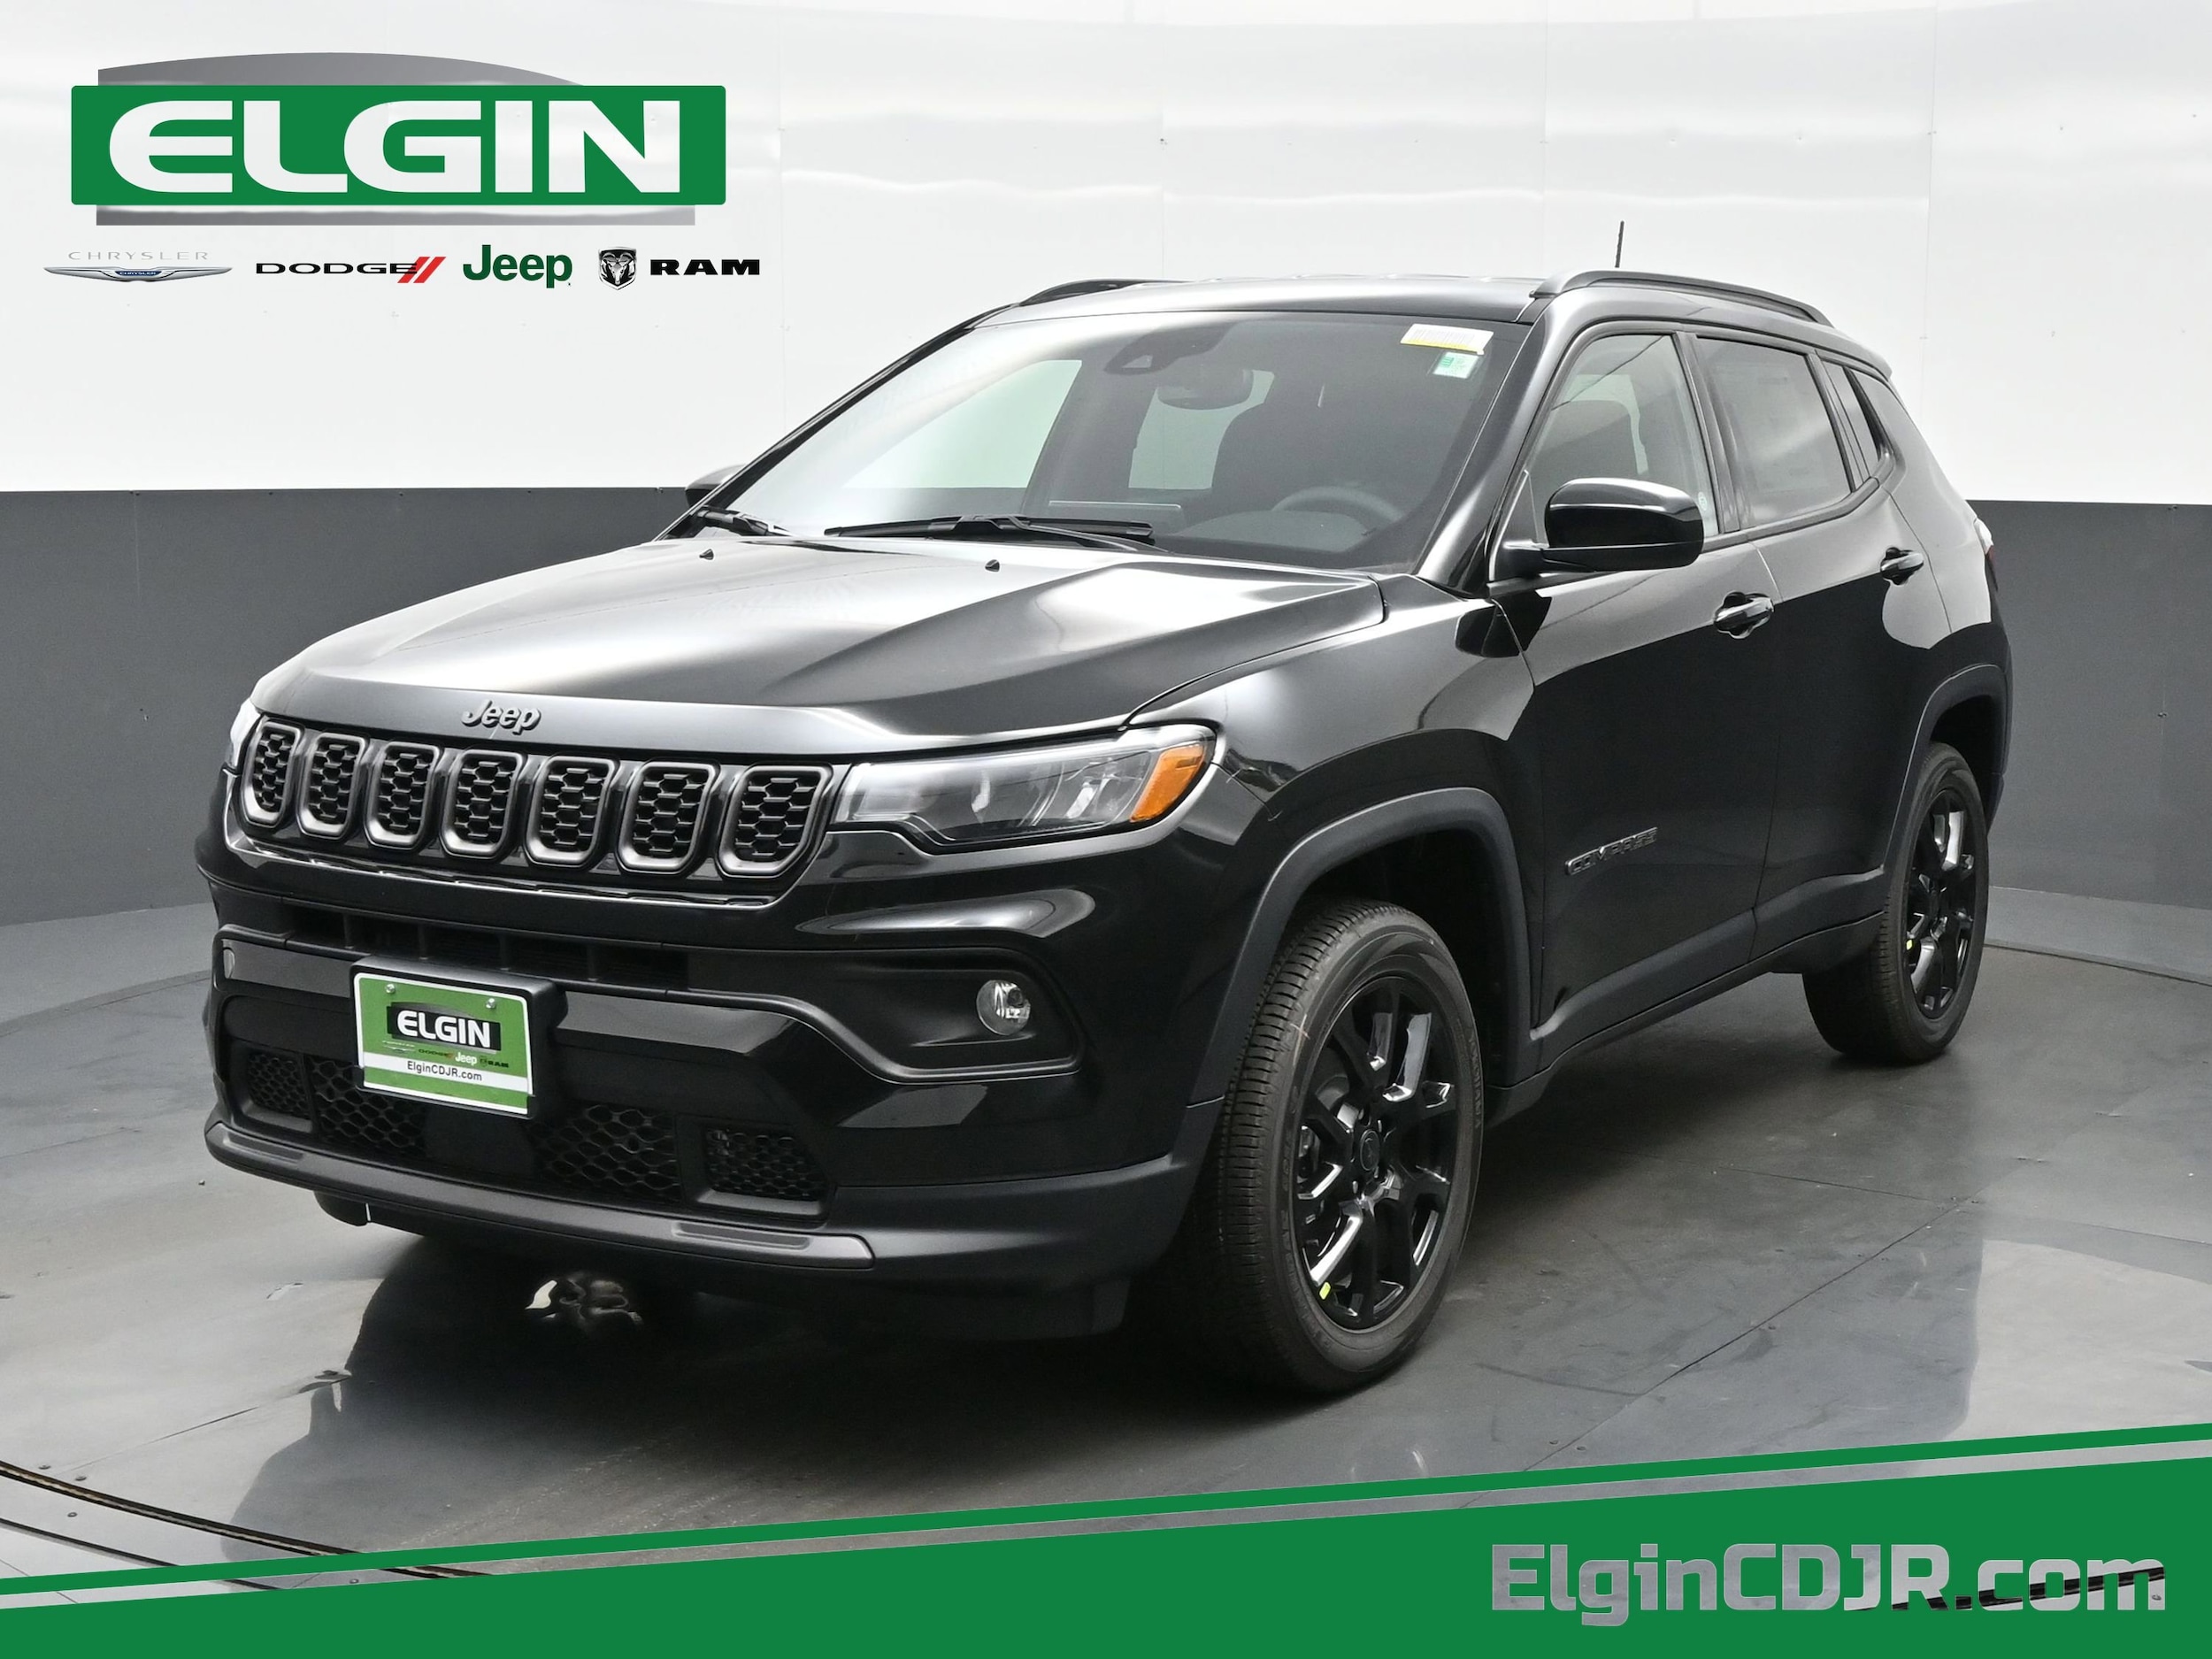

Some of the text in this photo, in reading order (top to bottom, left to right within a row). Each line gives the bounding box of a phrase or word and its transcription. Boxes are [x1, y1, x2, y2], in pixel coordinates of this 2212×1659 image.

[461, 699, 541, 735] Jeep
[397, 1010, 491, 1048] ELGIN
[407, 1061, 482, 1080] ElginCDJR.com
[455, 1052, 477, 1065] Jeep
